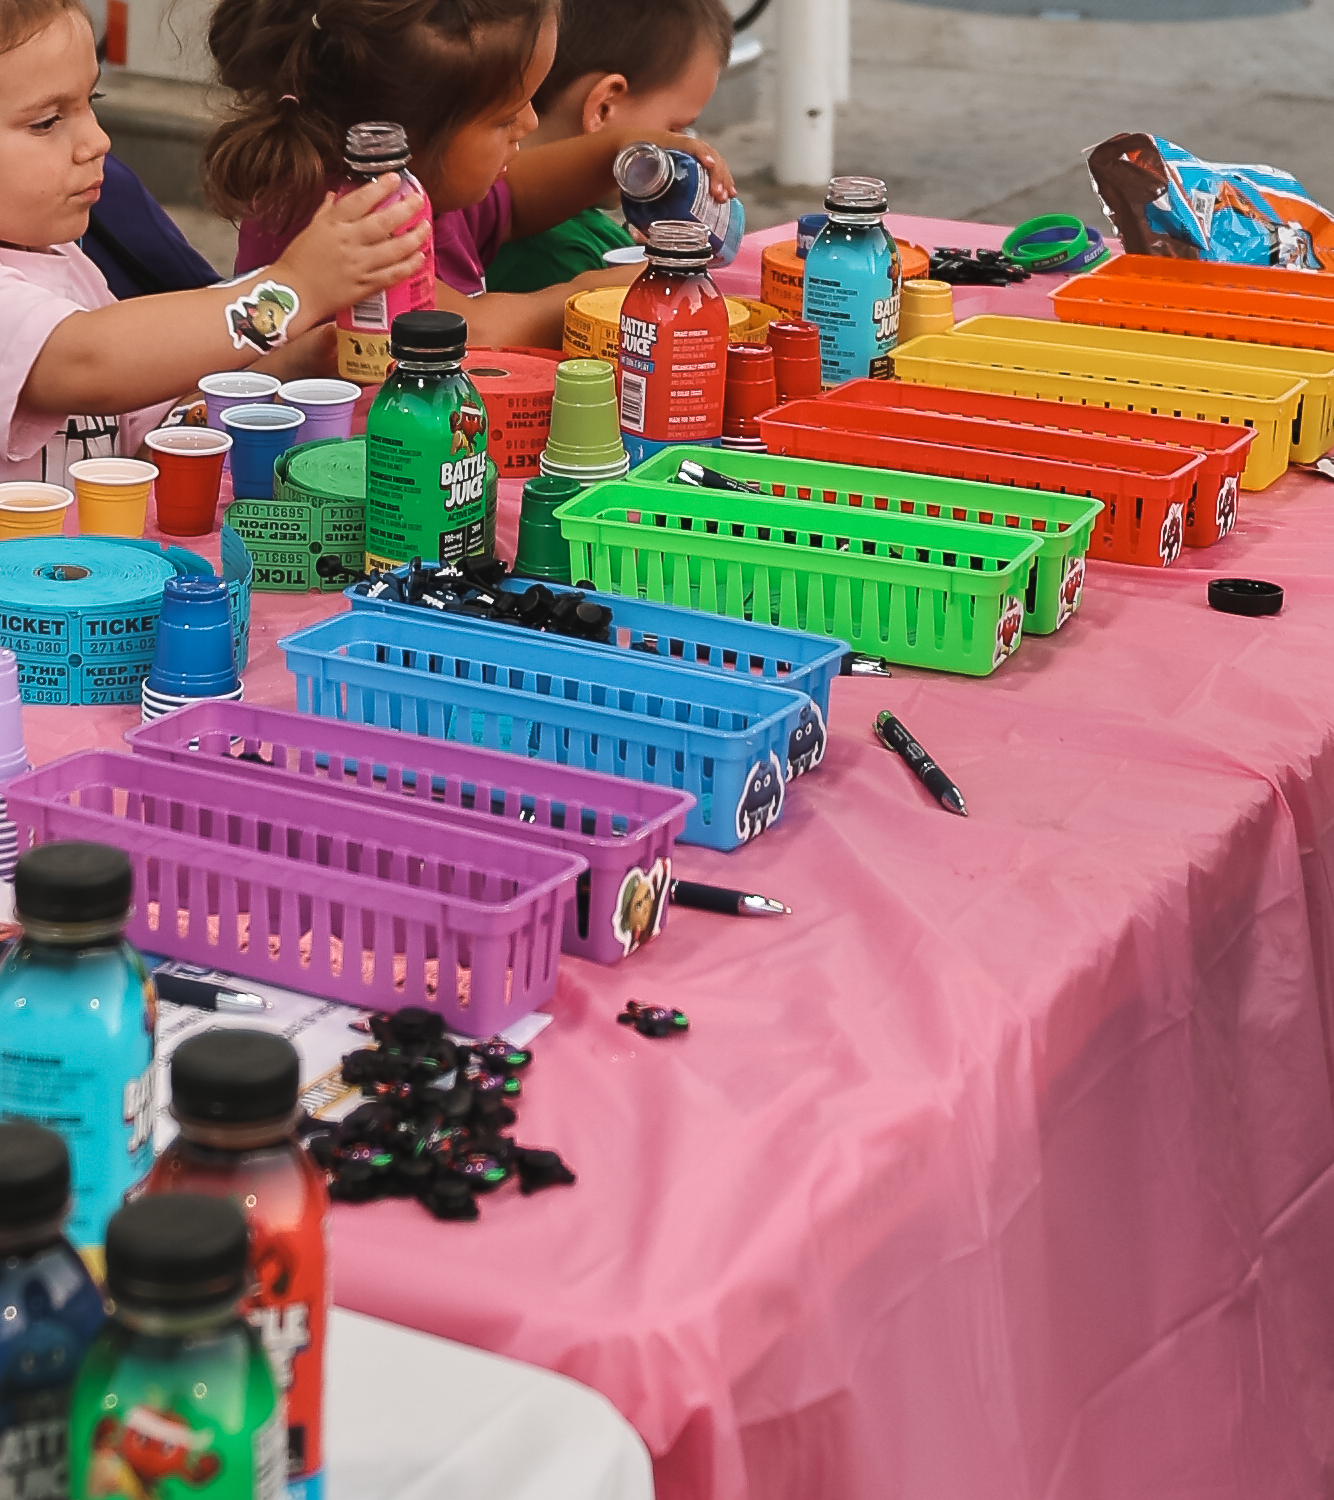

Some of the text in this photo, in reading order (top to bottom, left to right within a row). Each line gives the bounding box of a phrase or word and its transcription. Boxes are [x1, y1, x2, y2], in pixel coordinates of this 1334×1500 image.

[621, 314, 657, 341] BATTLE
[622, 333, 651, 356] JUICE
[512, 411, 551, 420] OUPON
[441, 451, 486, 486] BATTLE
[505, 454, 539, 469] KET
[445, 473, 485, 508] JUICE
[236, 504, 304, 519] 56931-013
[239, 520, 301, 532] COUPON
[269, 532, 307, 541] KEEP
[325, 533, 358, 541] THIS
[252, 551, 303, 564] 56931-0
[252, 570, 306, 585] TICK
[86, 615, 158, 636] TICKE
[90, 638, 155, 654] 27145-02
[30, 666, 66, 677] THIS
[86, 663, 152, 677] KEEP TH
[18, 674, 59, 687] UPON
[23, 691, 62, 703] 5-030
[90, 691, 141, 703] 27145-
